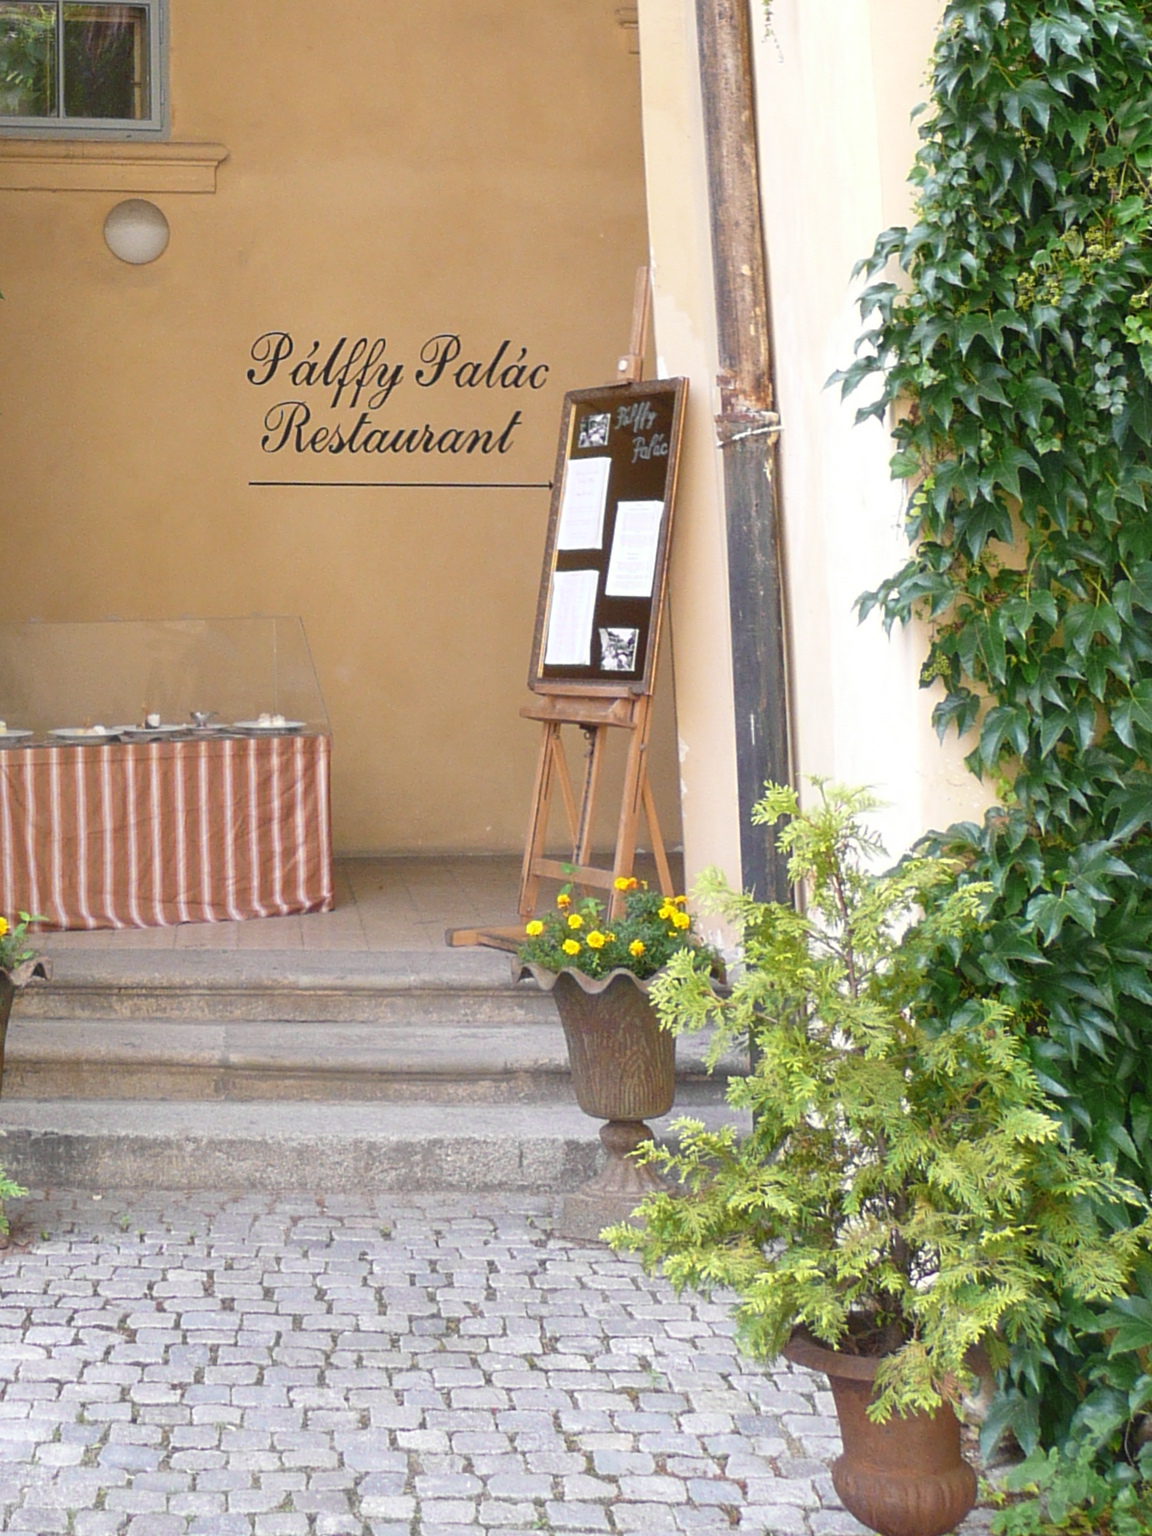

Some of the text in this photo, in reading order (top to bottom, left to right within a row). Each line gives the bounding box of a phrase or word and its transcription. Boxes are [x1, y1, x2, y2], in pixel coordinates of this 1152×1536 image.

[247, 331, 550, 410] Pálffy Palác
[261, 401, 522, 454] Restaurant
